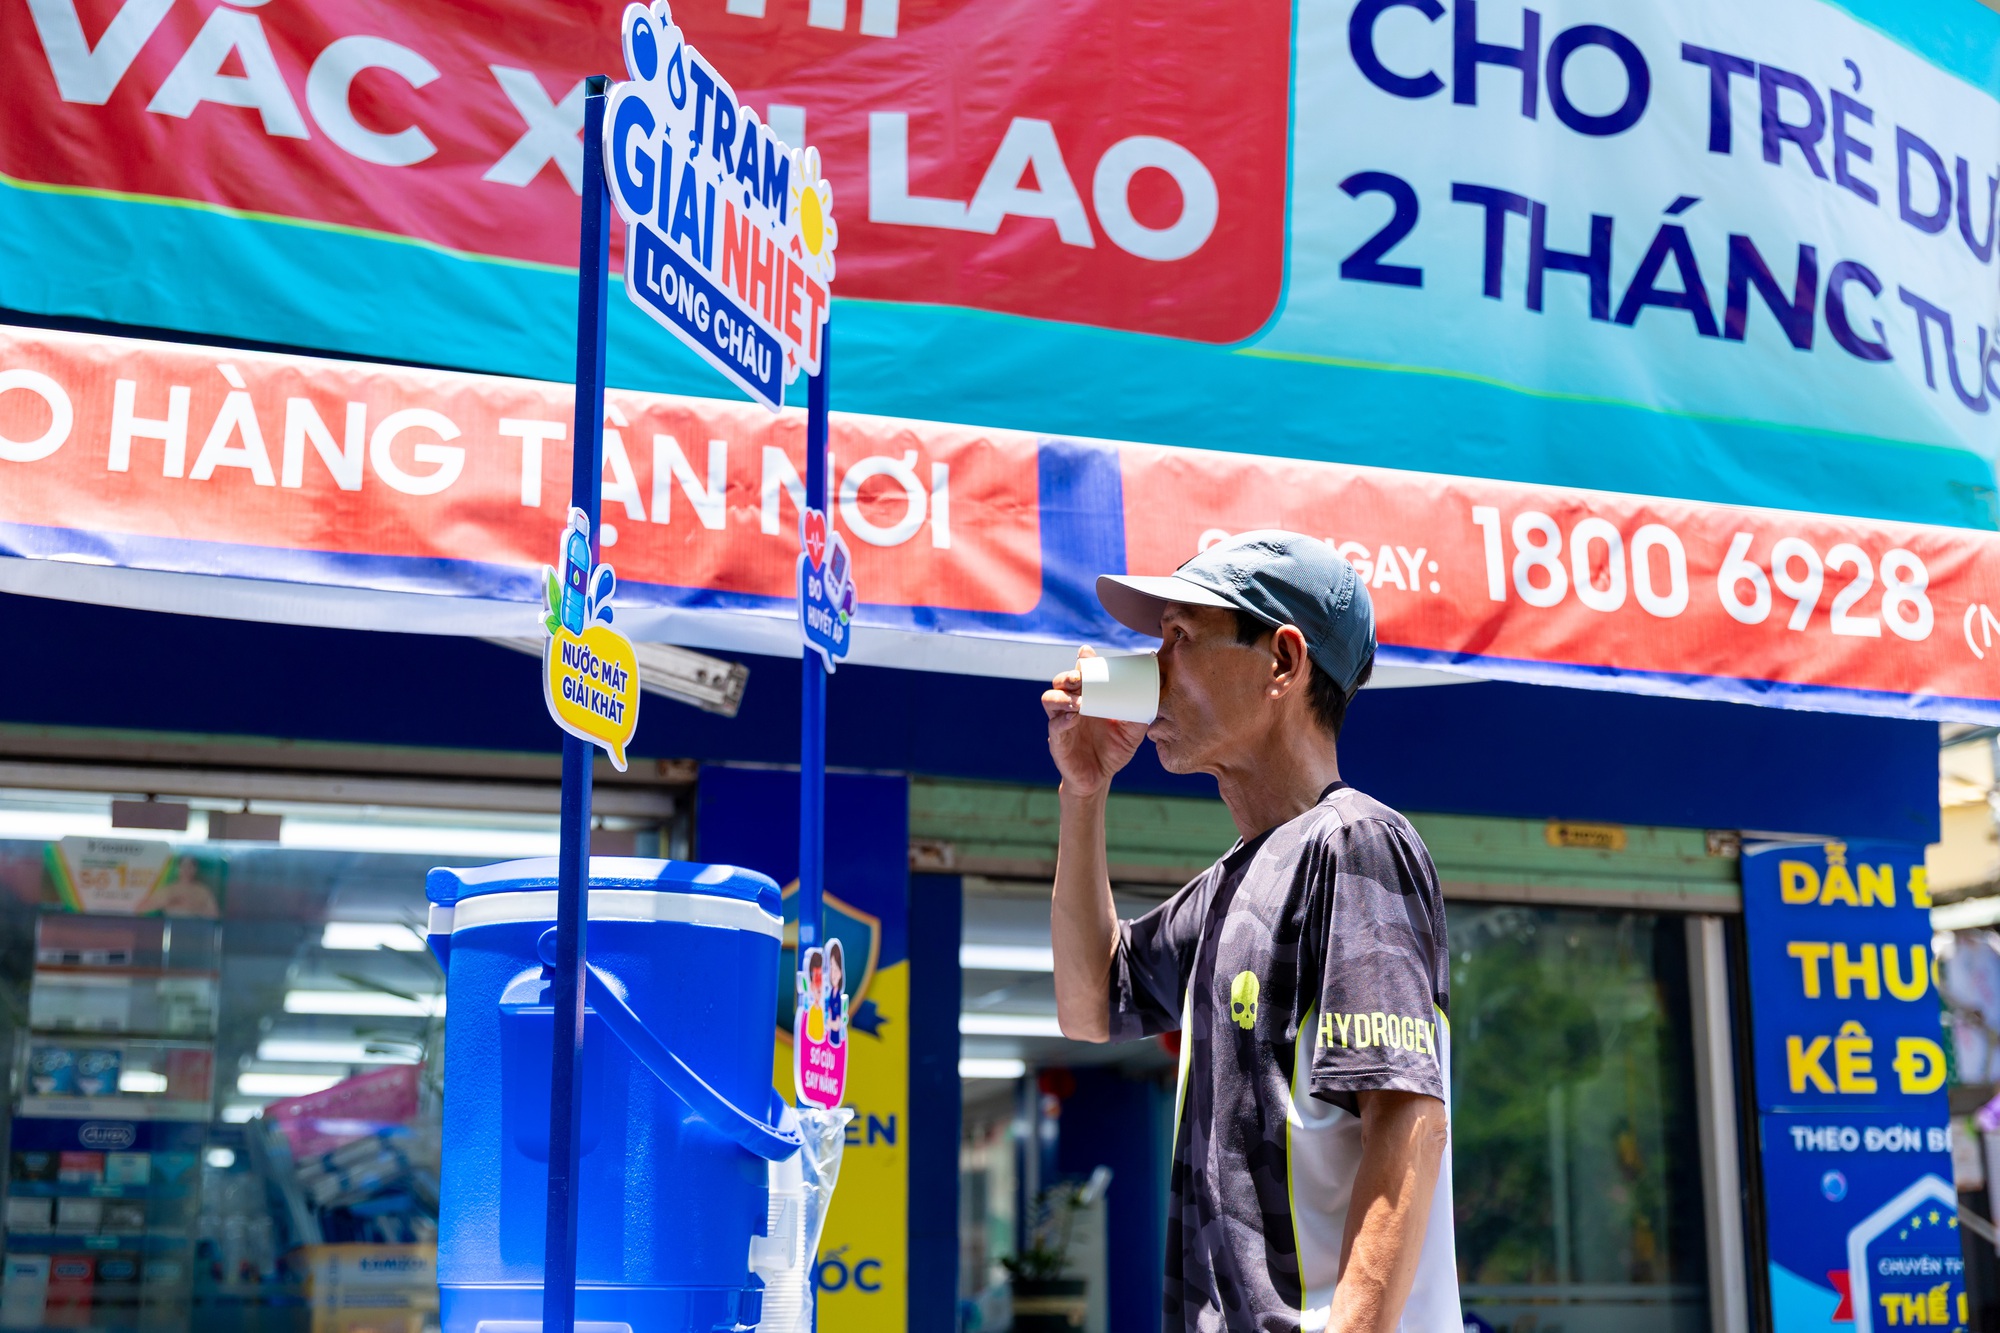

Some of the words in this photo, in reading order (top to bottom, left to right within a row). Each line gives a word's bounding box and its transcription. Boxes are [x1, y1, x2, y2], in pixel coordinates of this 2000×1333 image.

[690, 55, 789, 226] TRẠM
[1348, 0, 1651, 137] CHO
[1681, 42, 1879, 206] TRẺ
[613, 95, 715, 271] GIẢI
[868, 112, 1219, 261] LAO
[646, 248, 710, 333] LONG
[714, 309, 771, 384] CHÂU
[1338, 170, 1424, 288] 2
[1450, 195, 1894, 363] THÁNG
[107, 364, 466, 496] HÀNG
[761, 446, 951, 549] NƠI
[1325, 537, 1441, 594] GAY:
[1472, 505, 1689, 618] 1800
[1717, 532, 1934, 641] 6928
[562, 640, 600, 679] NƯỚC
[601, 661, 628, 693] MÁT
[562, 674, 590, 708] GIẢI
[591, 693, 625, 724] KHÁT
[1779, 842, 1897, 908] DẪN
[1786, 941, 1942, 1002] THU
[1317, 1011, 1436, 1055] HYDROGEN
[1786, 1020, 1878, 1094] KÊ
[1790, 1126, 1859, 1153] THEO
[1866, 1124, 1921, 1153] ĐƠN
[1927, 1126, 1953, 1153] B
[1878, 1253, 1943, 1276] CHUYÊN
